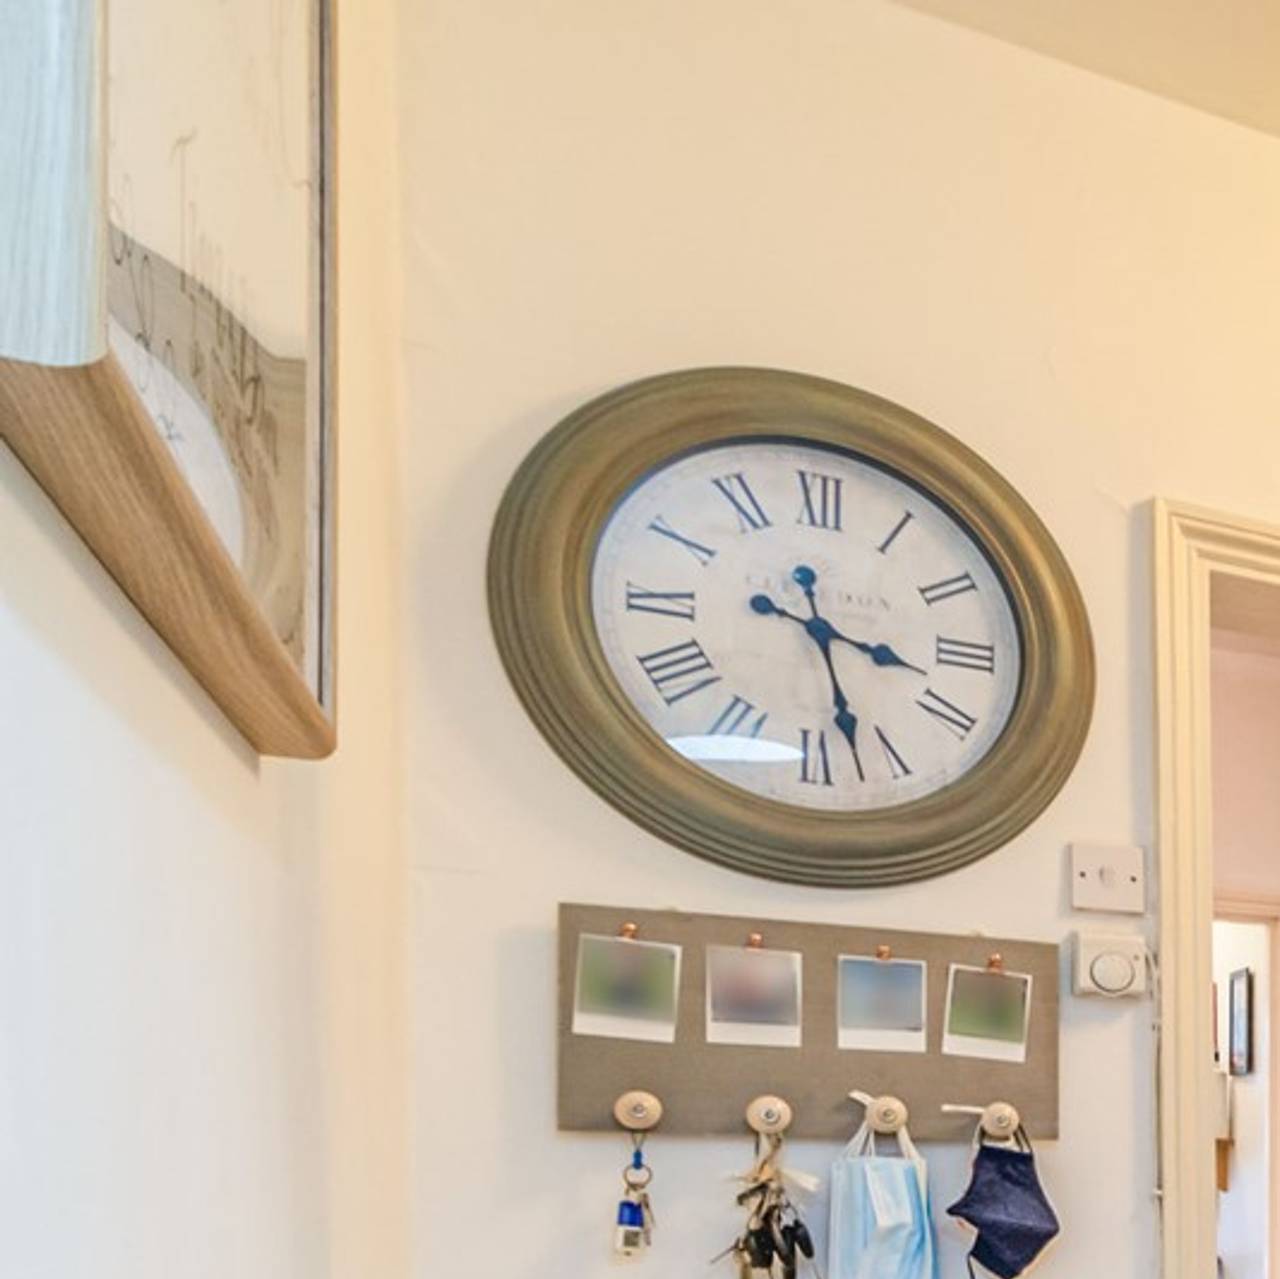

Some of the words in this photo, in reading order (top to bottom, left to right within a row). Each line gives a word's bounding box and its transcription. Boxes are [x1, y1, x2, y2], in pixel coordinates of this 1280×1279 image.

[711, 471, 773, 534] XI
[797, 469, 842, 531] XII
[648, 514, 717, 566] X
[877, 510, 914, 555] I
[626, 580, 695, 621] IX
[918, 572, 978, 606] II
[636, 638, 722, 706] VIII
[936, 634, 994, 674] III
[915, 687, 978, 741] IV
[799, 728, 834, 786] VI
[873, 725, 912, 780] V
